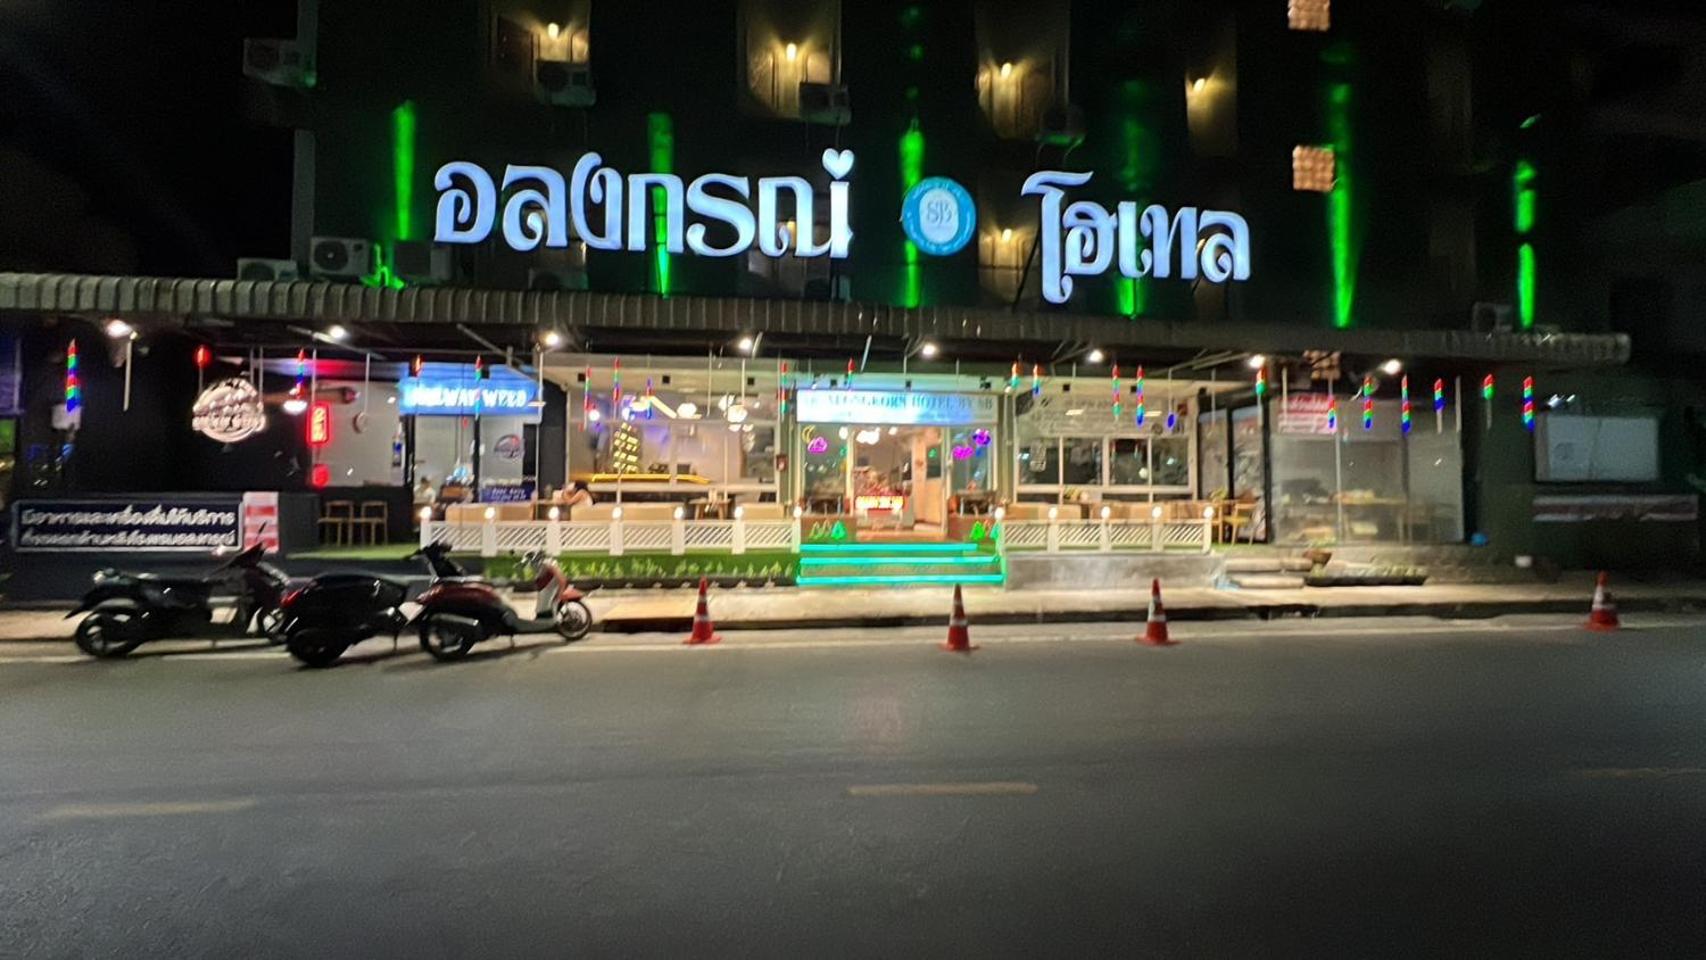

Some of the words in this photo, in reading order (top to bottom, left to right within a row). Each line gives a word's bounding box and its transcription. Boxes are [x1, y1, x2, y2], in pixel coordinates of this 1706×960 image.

[434, 148, 856, 259] อลงกรณ์
[1021, 170, 1253, 304] โฮเทล
